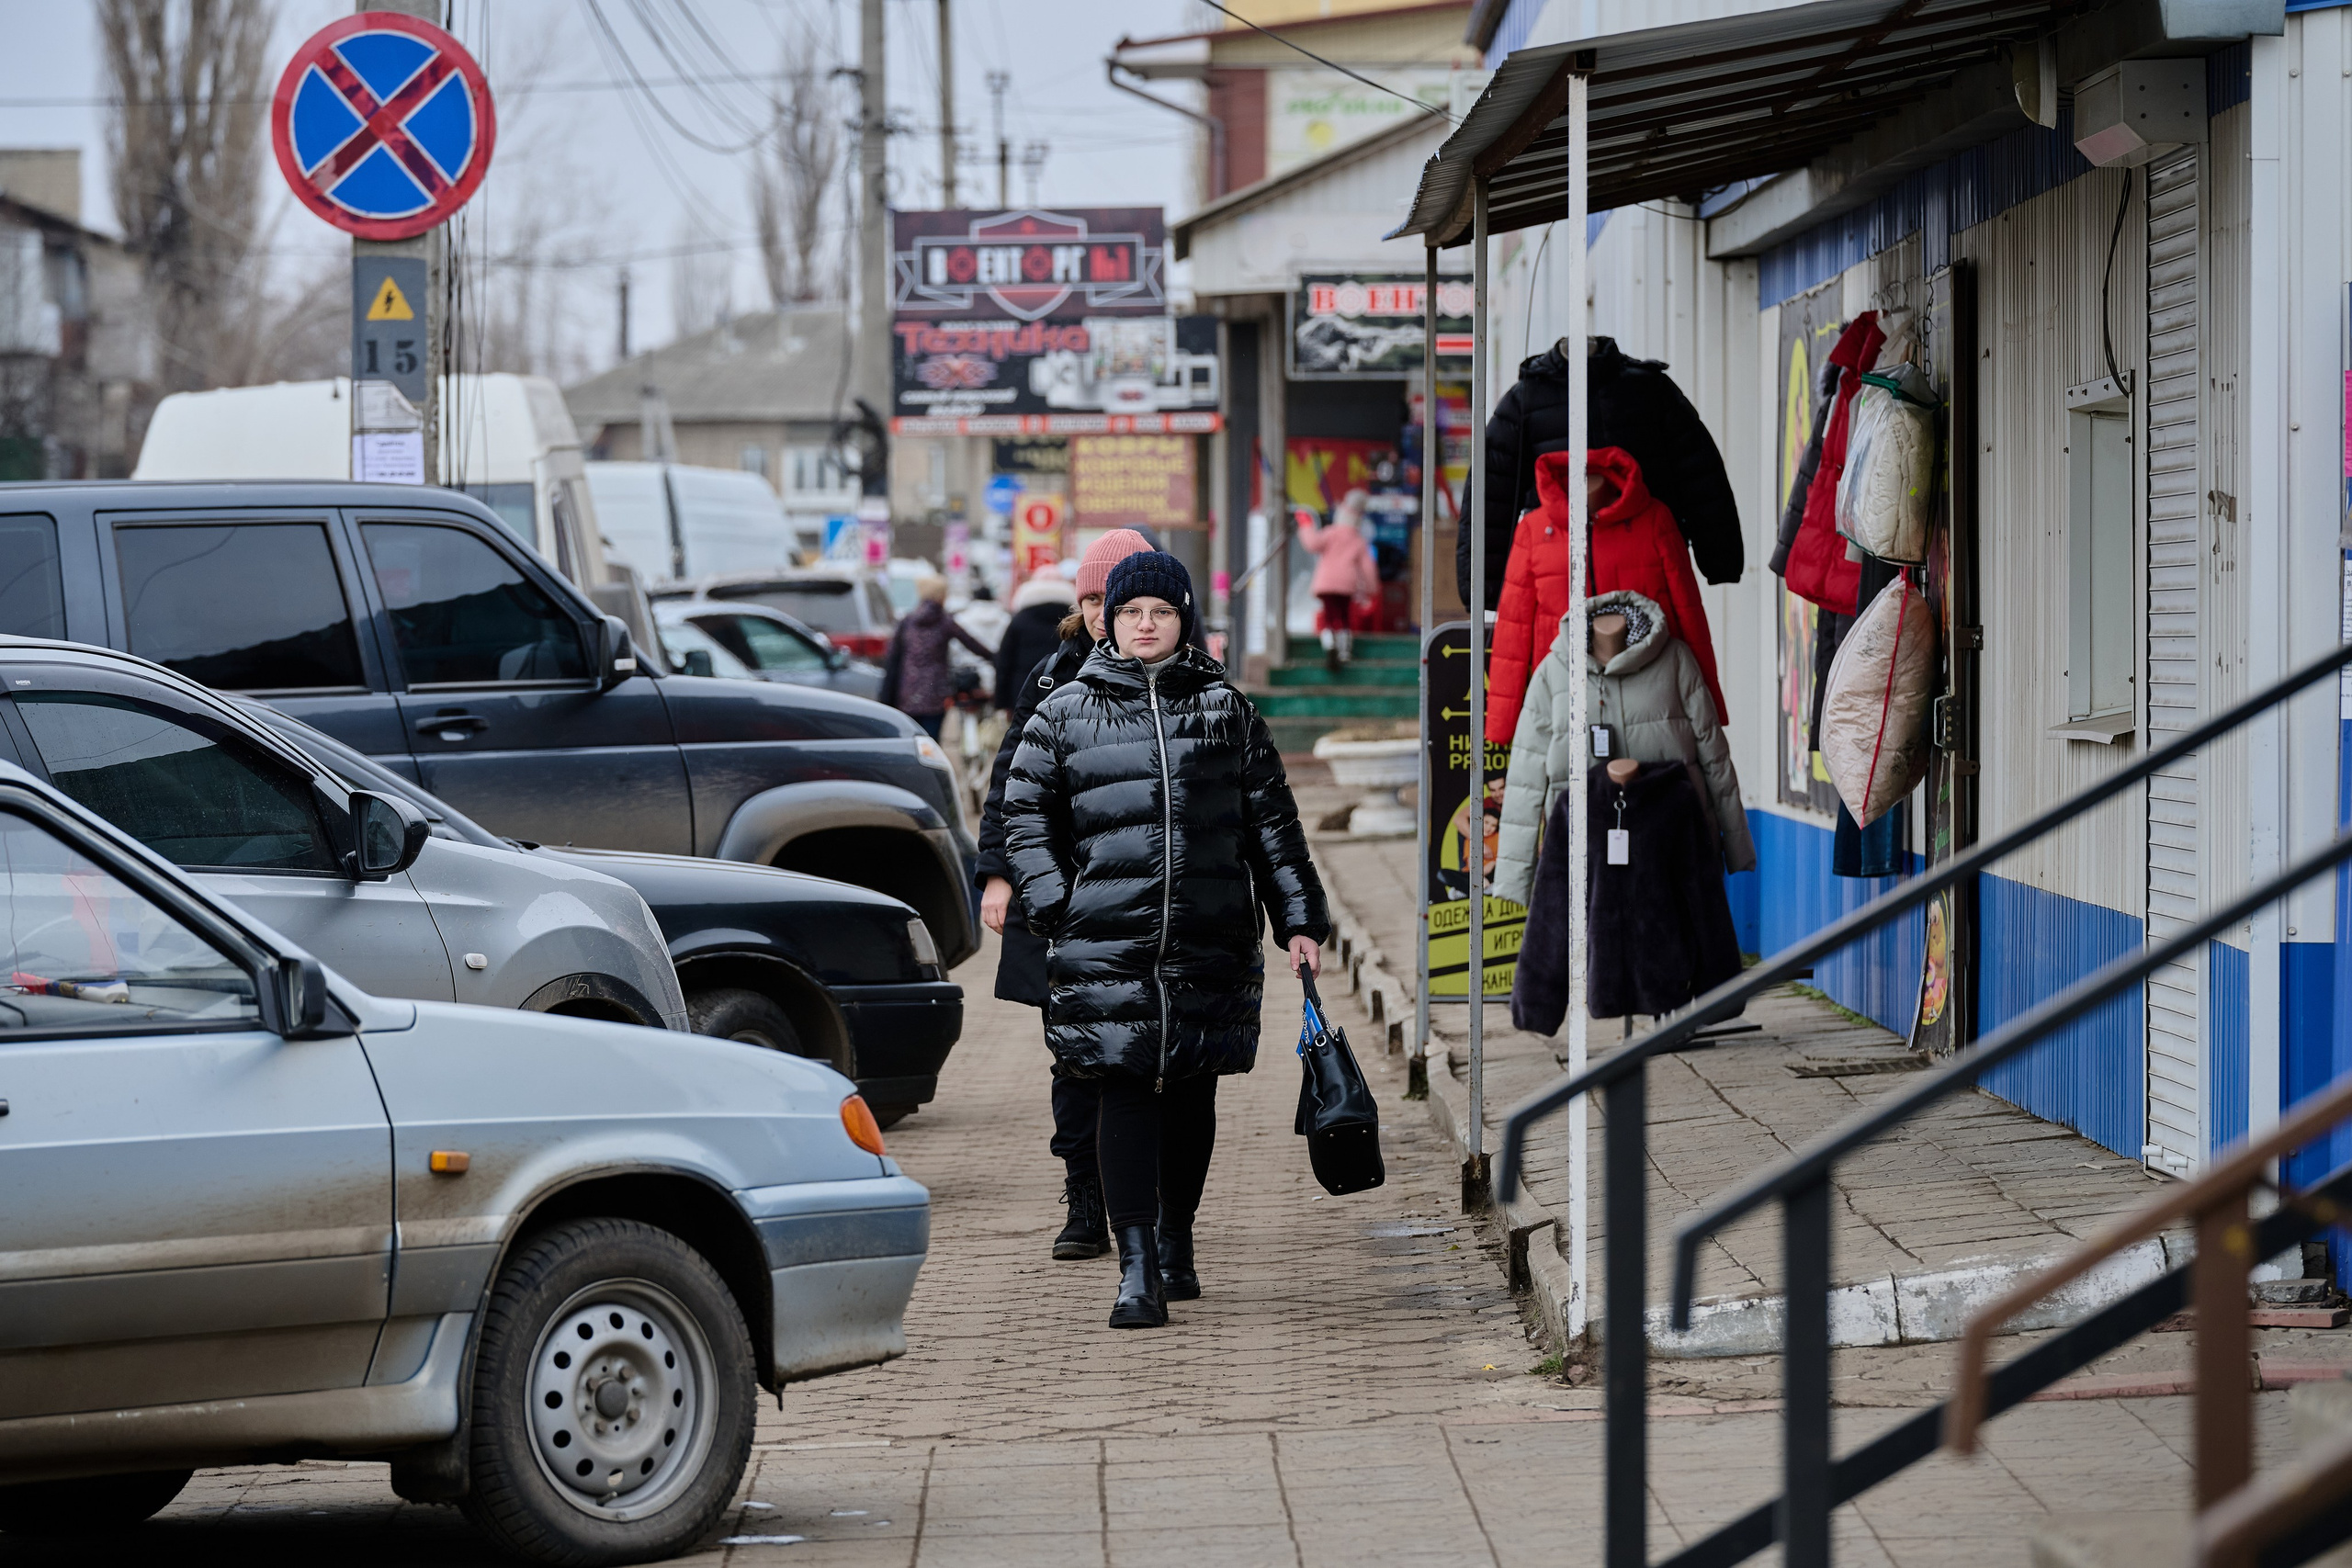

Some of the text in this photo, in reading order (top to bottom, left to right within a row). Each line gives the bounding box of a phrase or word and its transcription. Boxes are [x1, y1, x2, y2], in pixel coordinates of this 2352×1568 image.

[928, 244, 1086, 286] ВОЕНТОРГ
[366, 339, 417, 375] 15
[1449, 753, 1511, 772] РЯДО
[1494, 931, 1524, 951] ИГР
